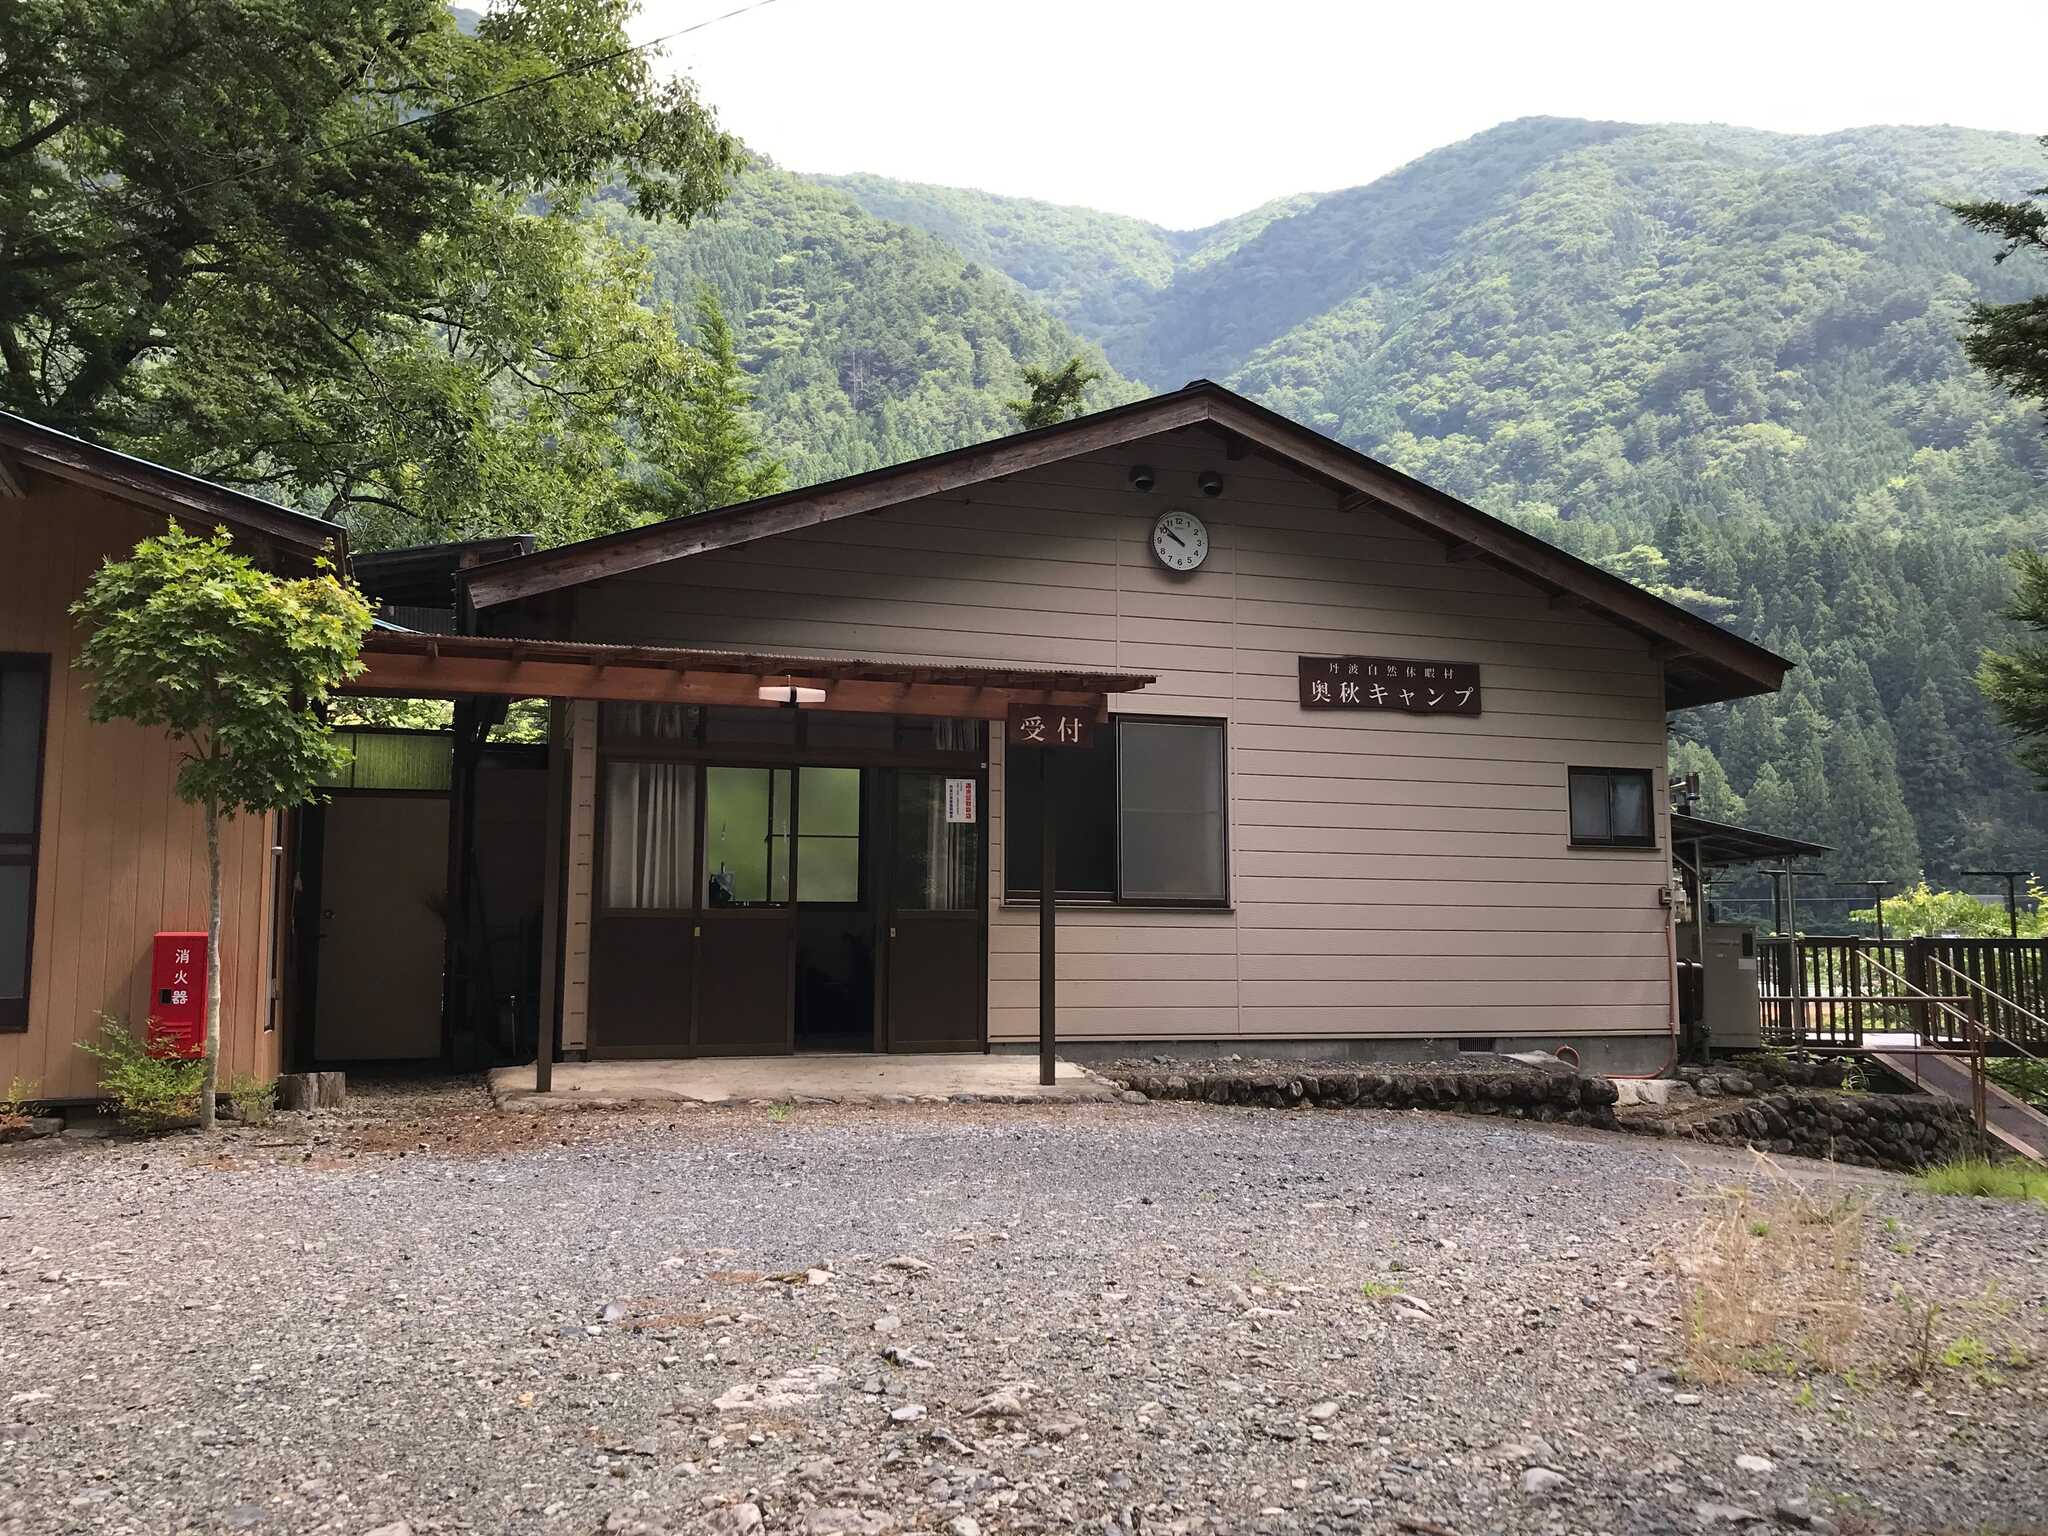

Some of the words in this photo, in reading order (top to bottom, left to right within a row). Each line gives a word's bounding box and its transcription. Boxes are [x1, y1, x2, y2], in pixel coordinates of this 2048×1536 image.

[1193, 528, 1199, 536] 2
[1156, 536, 1162, 544] 9
[1196, 539, 1202, 547] 3
[1160, 547, 1166, 555] 8
[1177, 558, 1183, 566] 6
[1186, 556, 1193, 564] 5
[1328, 663, 1456, 680] 丹波自然休暇村
[1312, 680, 1474, 706] 奥秋キャンプ
[1020, 715, 1083, 743] 受付
[171, 948, 190, 1005] 消火器
